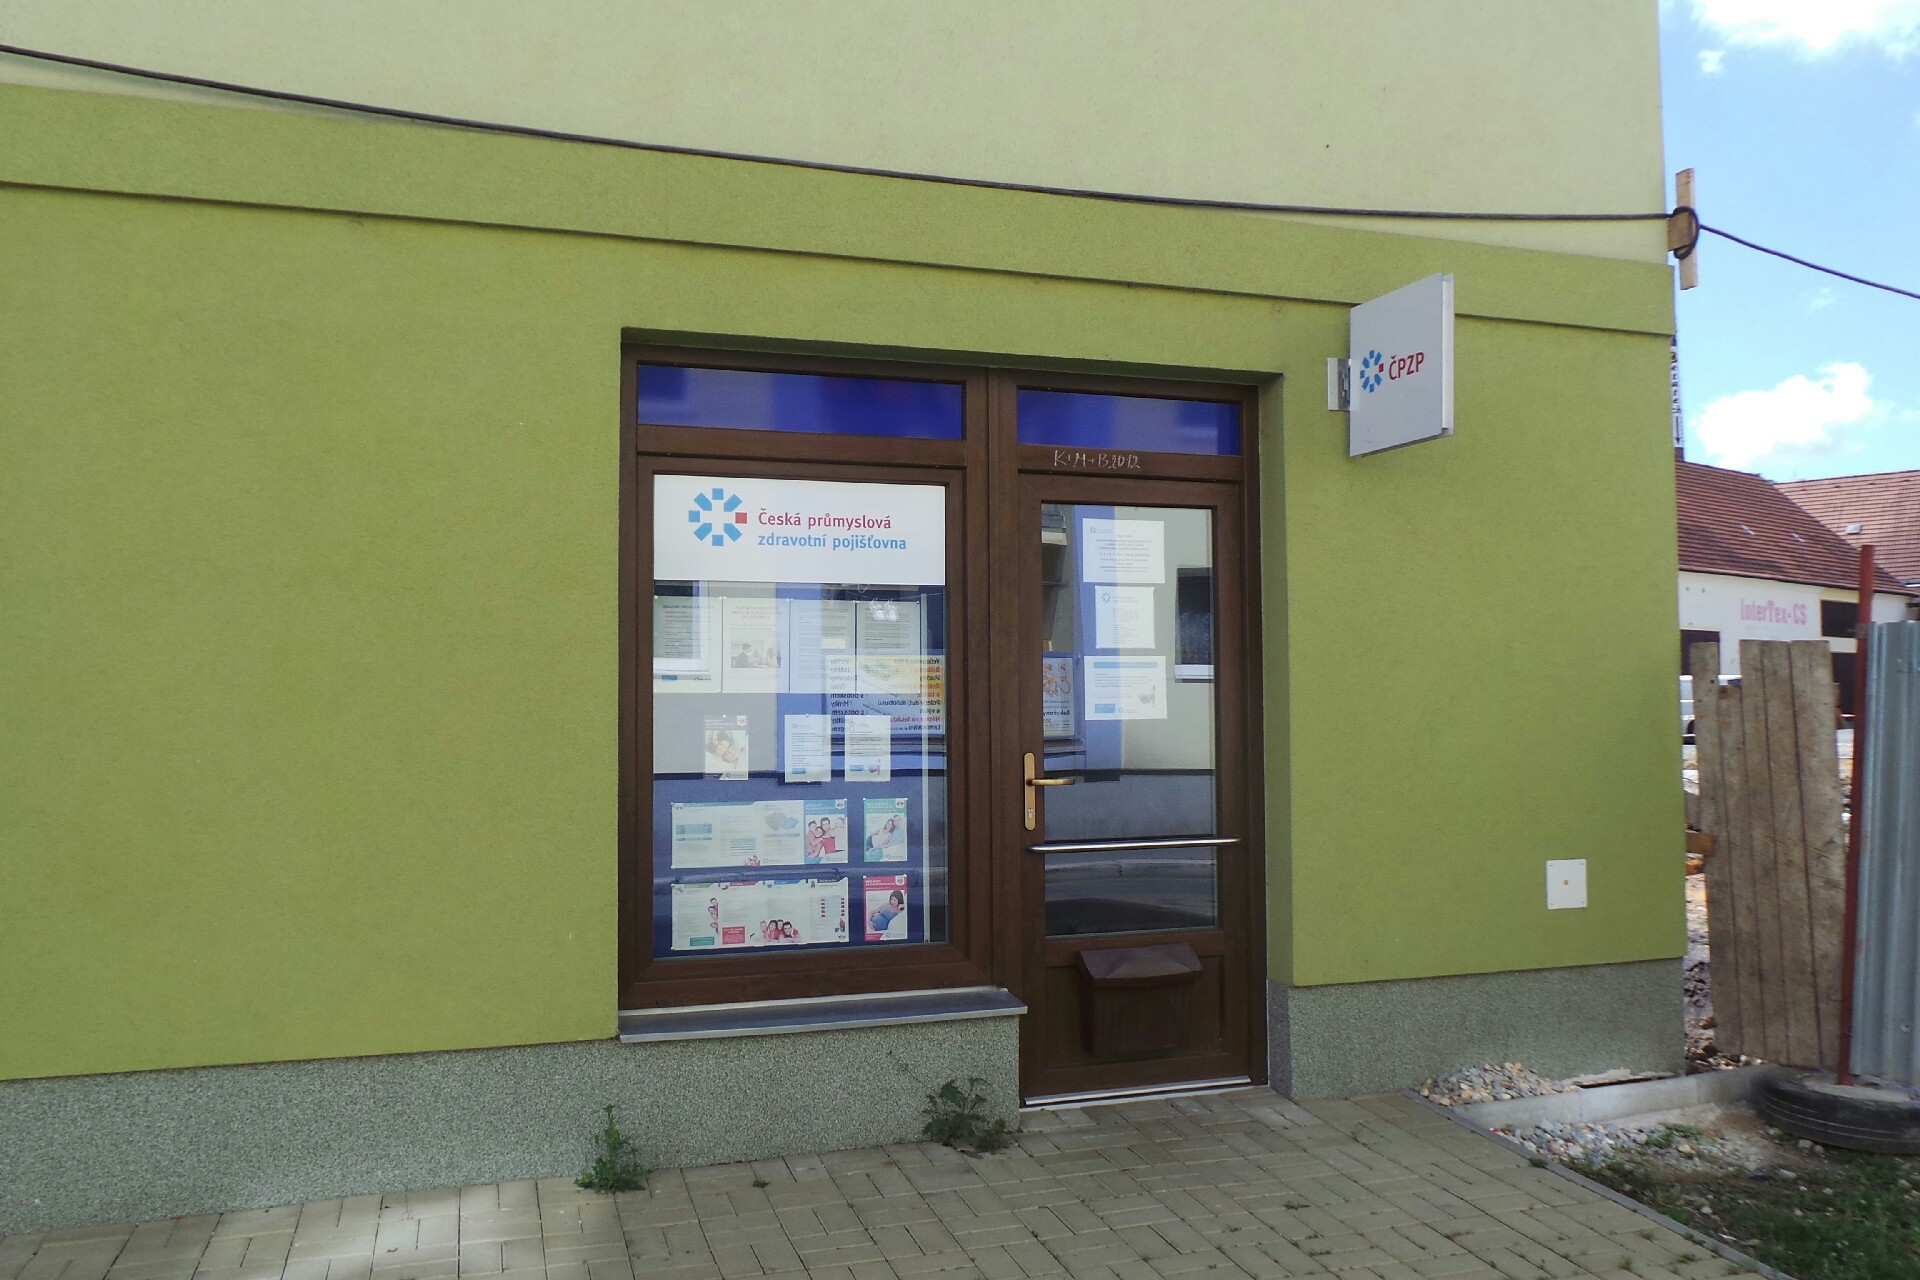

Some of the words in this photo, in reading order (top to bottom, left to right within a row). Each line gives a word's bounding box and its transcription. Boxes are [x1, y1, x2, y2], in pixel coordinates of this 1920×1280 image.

[1389, 352, 1424, 380] ČPZP
[758, 508, 801, 526] Česká
[808, 513, 892, 531] průmyslová
[757, 532, 827, 548] zdravotní
[832, 534, 907, 551] pojišťovna
